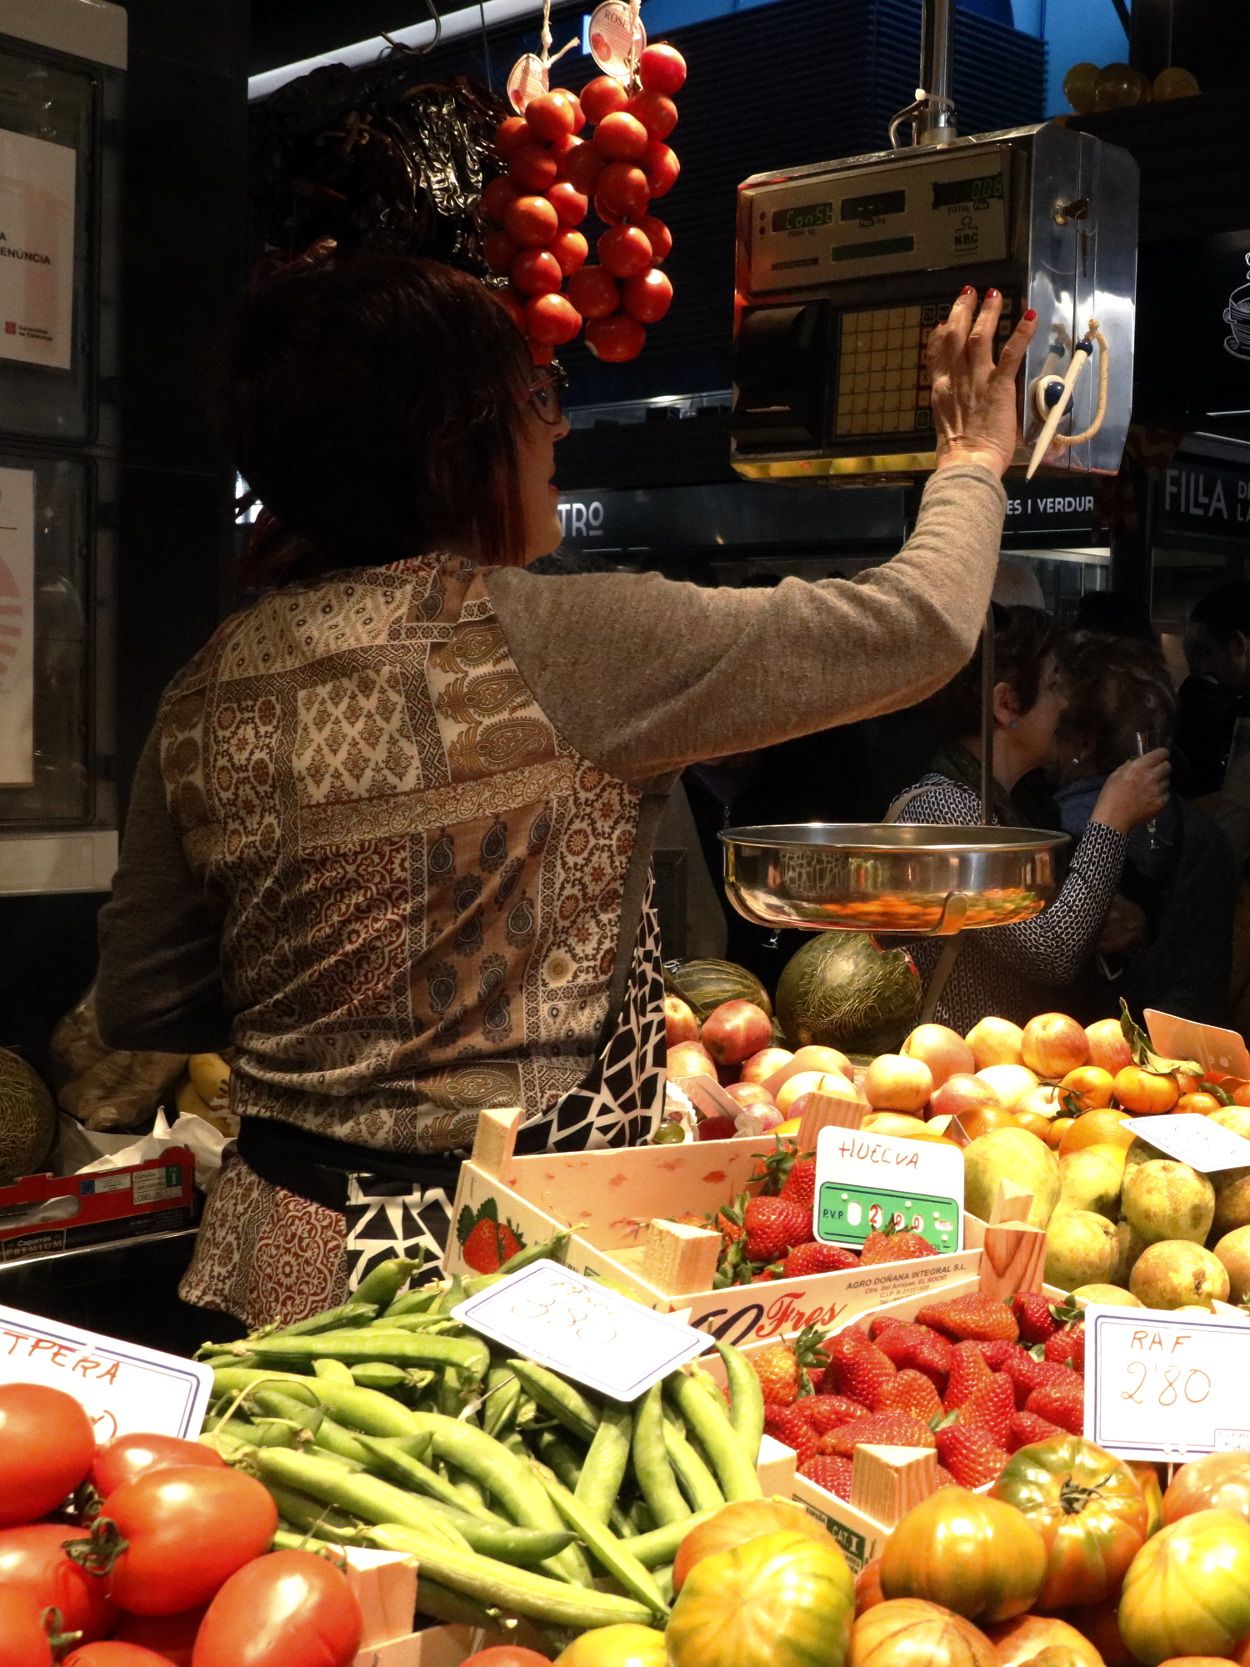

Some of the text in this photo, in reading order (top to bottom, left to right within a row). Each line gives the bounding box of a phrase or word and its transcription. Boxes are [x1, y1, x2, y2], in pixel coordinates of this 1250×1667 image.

[1165, 469, 1228, 520] FILLA
[847, 1278, 872, 1290] AGRO
[874, 1271, 910, 1286] DOÑANA
[911, 1264, 951, 1279] INTEGRAL
[1131, 1330, 1193, 1355] RAF
